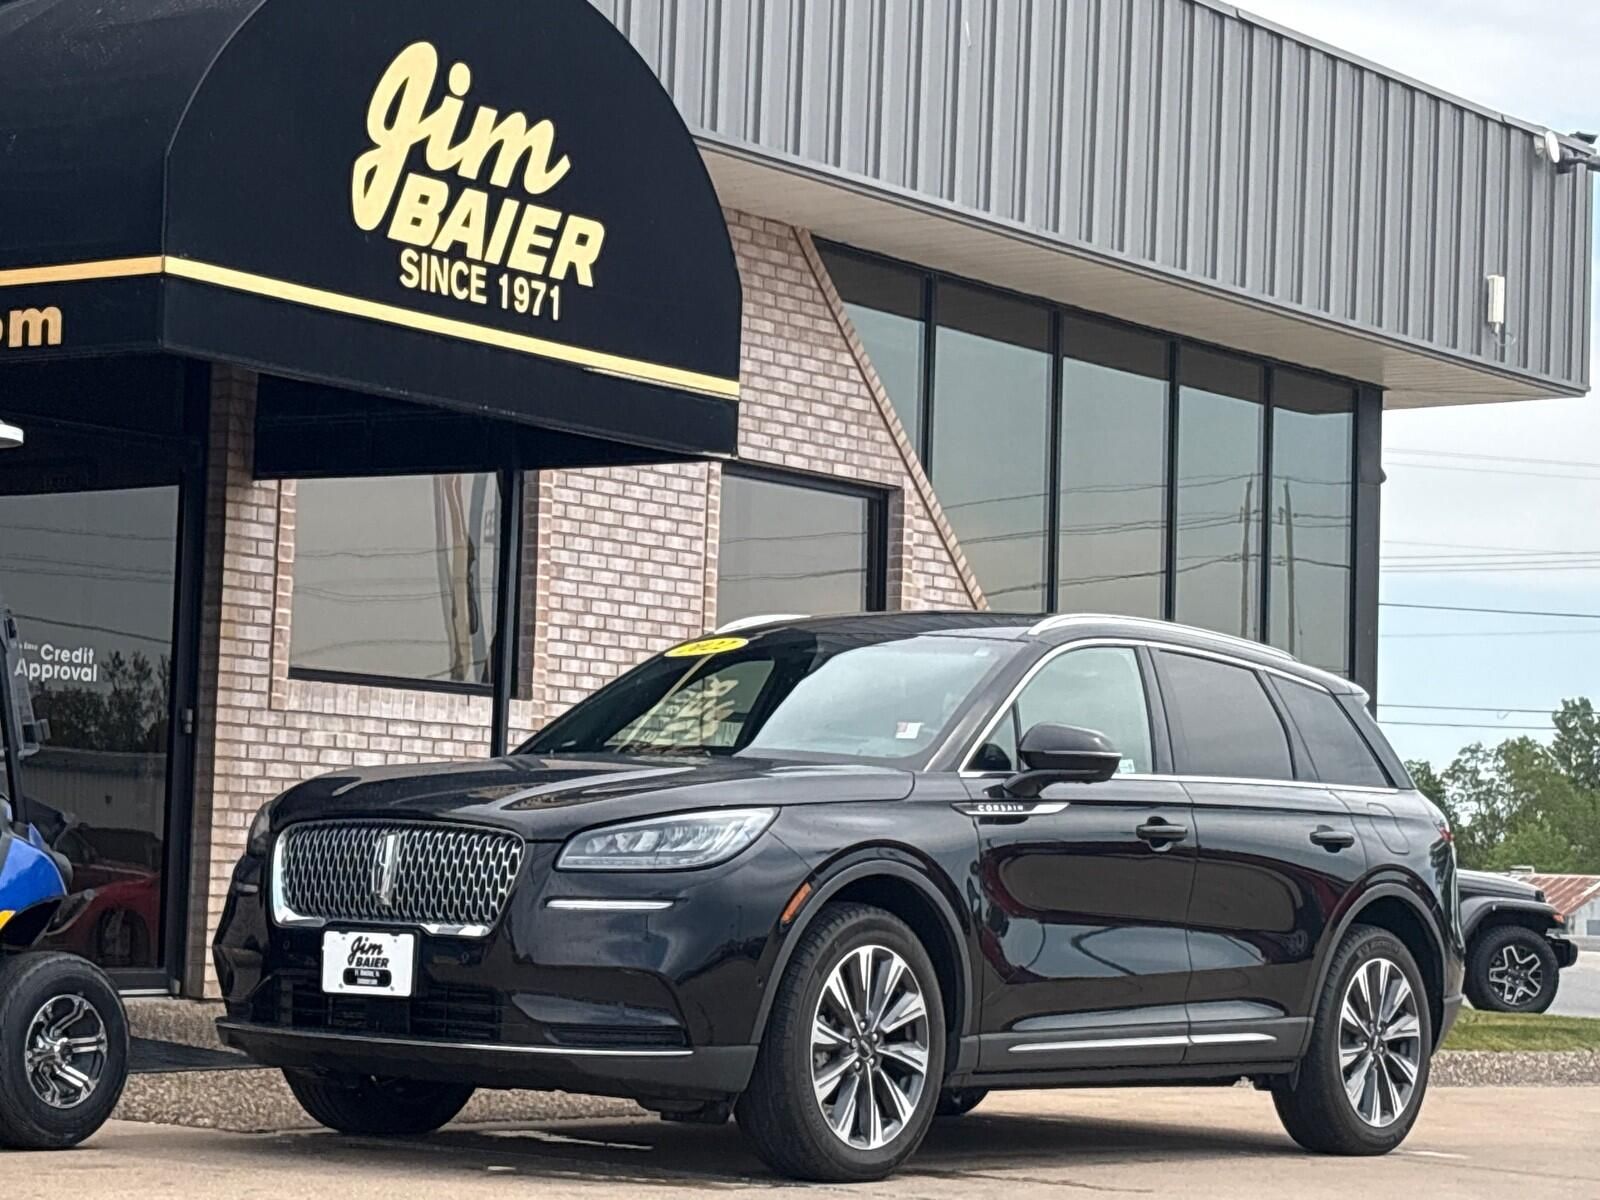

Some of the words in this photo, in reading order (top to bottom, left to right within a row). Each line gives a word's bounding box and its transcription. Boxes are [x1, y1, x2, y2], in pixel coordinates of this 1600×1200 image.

[352, 41, 571, 231] Jim
[387, 172, 605, 287] BAIER
[400, 248, 487, 304] SINCE
[499, 273, 560, 321] 1971
[40, 643, 94, 664] Credit
[14, 658, 97, 682] Approval
[347, 936, 383, 966] Jim
[355, 957, 389, 968] BAIER
